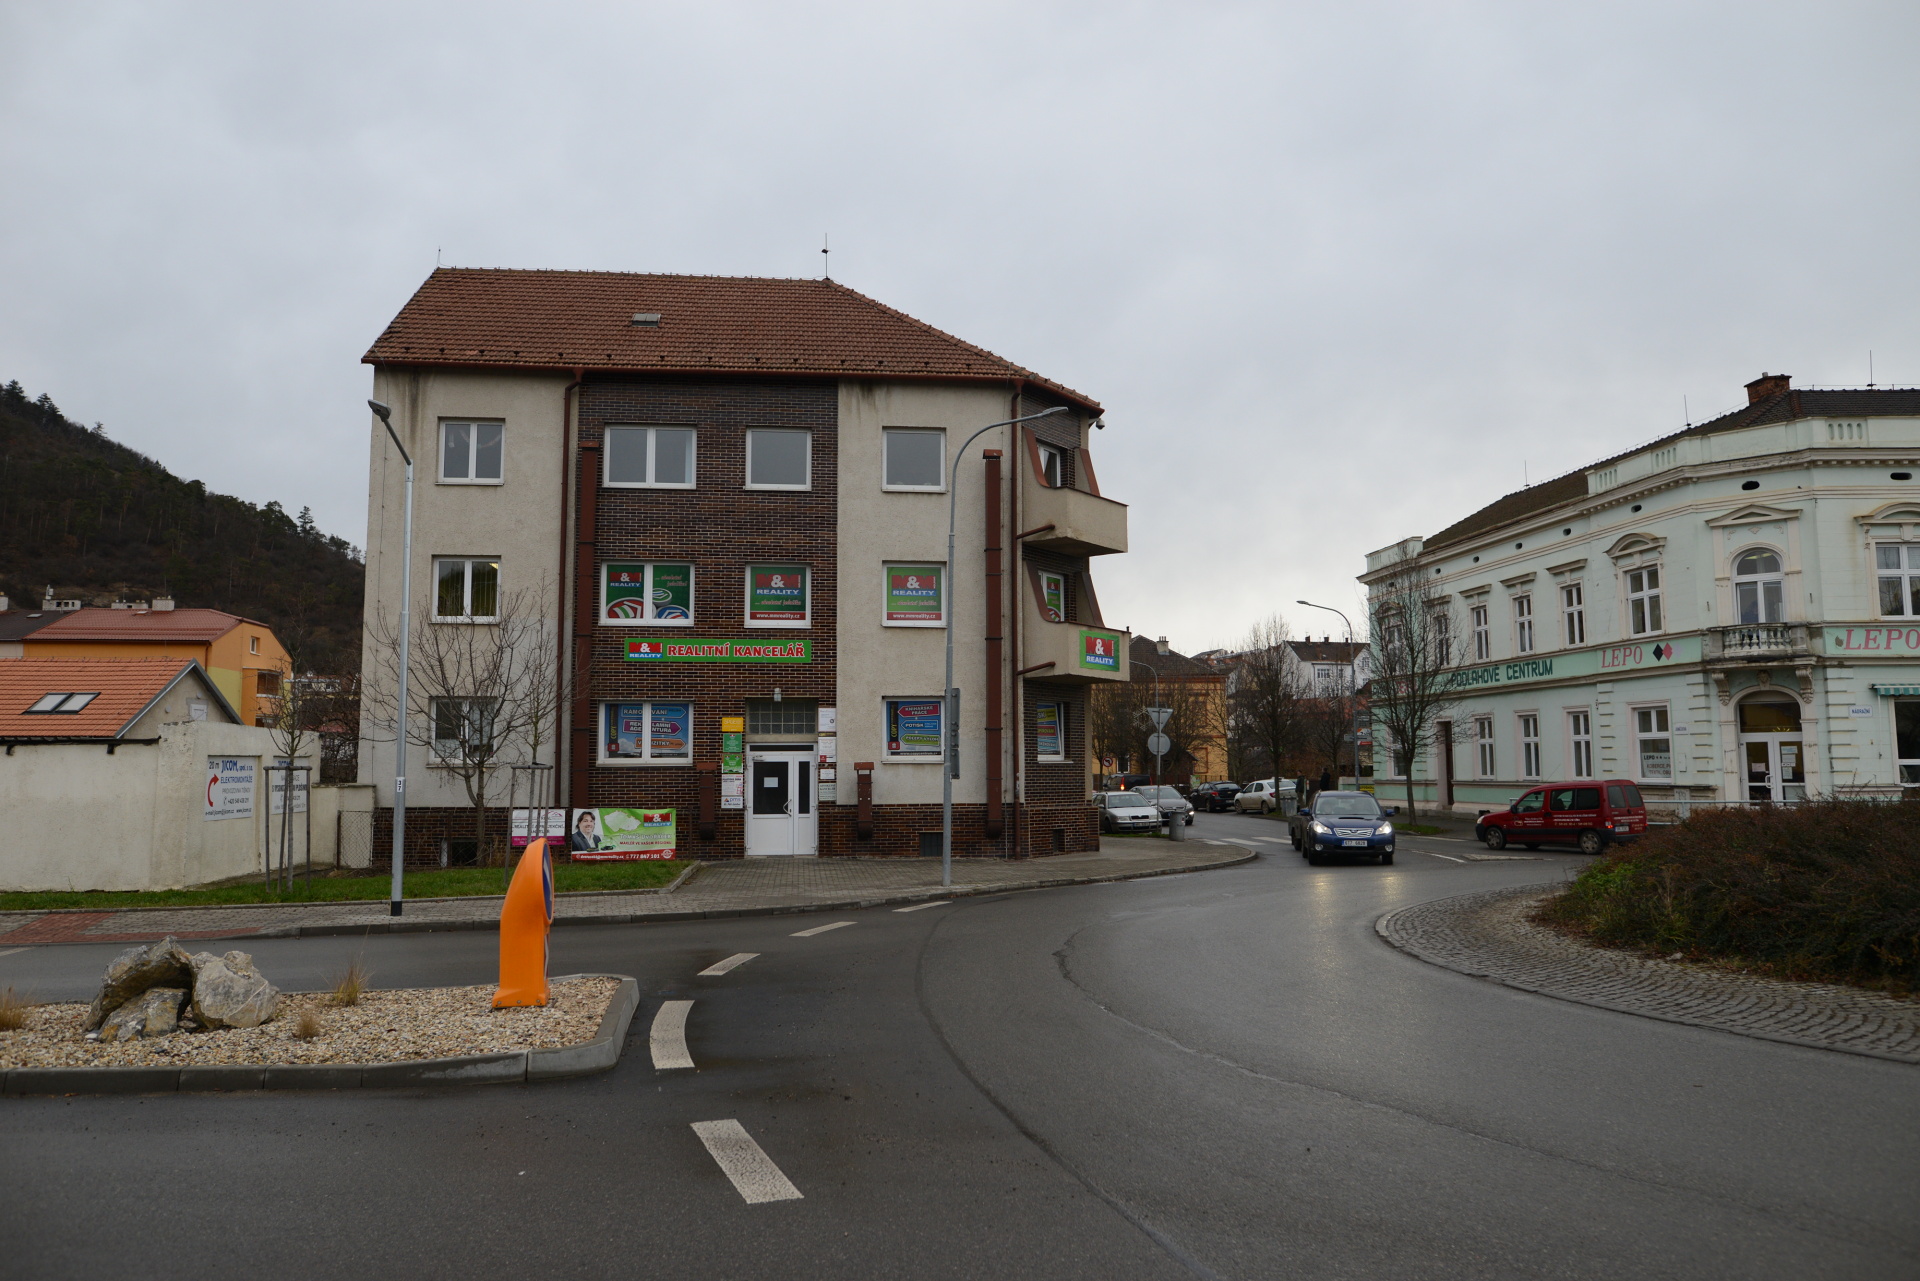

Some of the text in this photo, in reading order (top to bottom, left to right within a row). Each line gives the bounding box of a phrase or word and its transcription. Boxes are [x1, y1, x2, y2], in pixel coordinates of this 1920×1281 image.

[756, 574, 798, 588] M&M
[892, 575, 934, 589] M&M
[629, 642, 661, 652] M&M
[1086, 636, 1112, 656] M&M
[1844, 629, 1920, 650] LEPO
[667, 642, 805, 658] REALITNÍ KANCELÁŘ
[1601, 646, 1643, 668] LEPO
[1086, 655, 1114, 665] REALITY
[1451, 659, 1553, 687] PODLAHOVÉ CENTRUM
